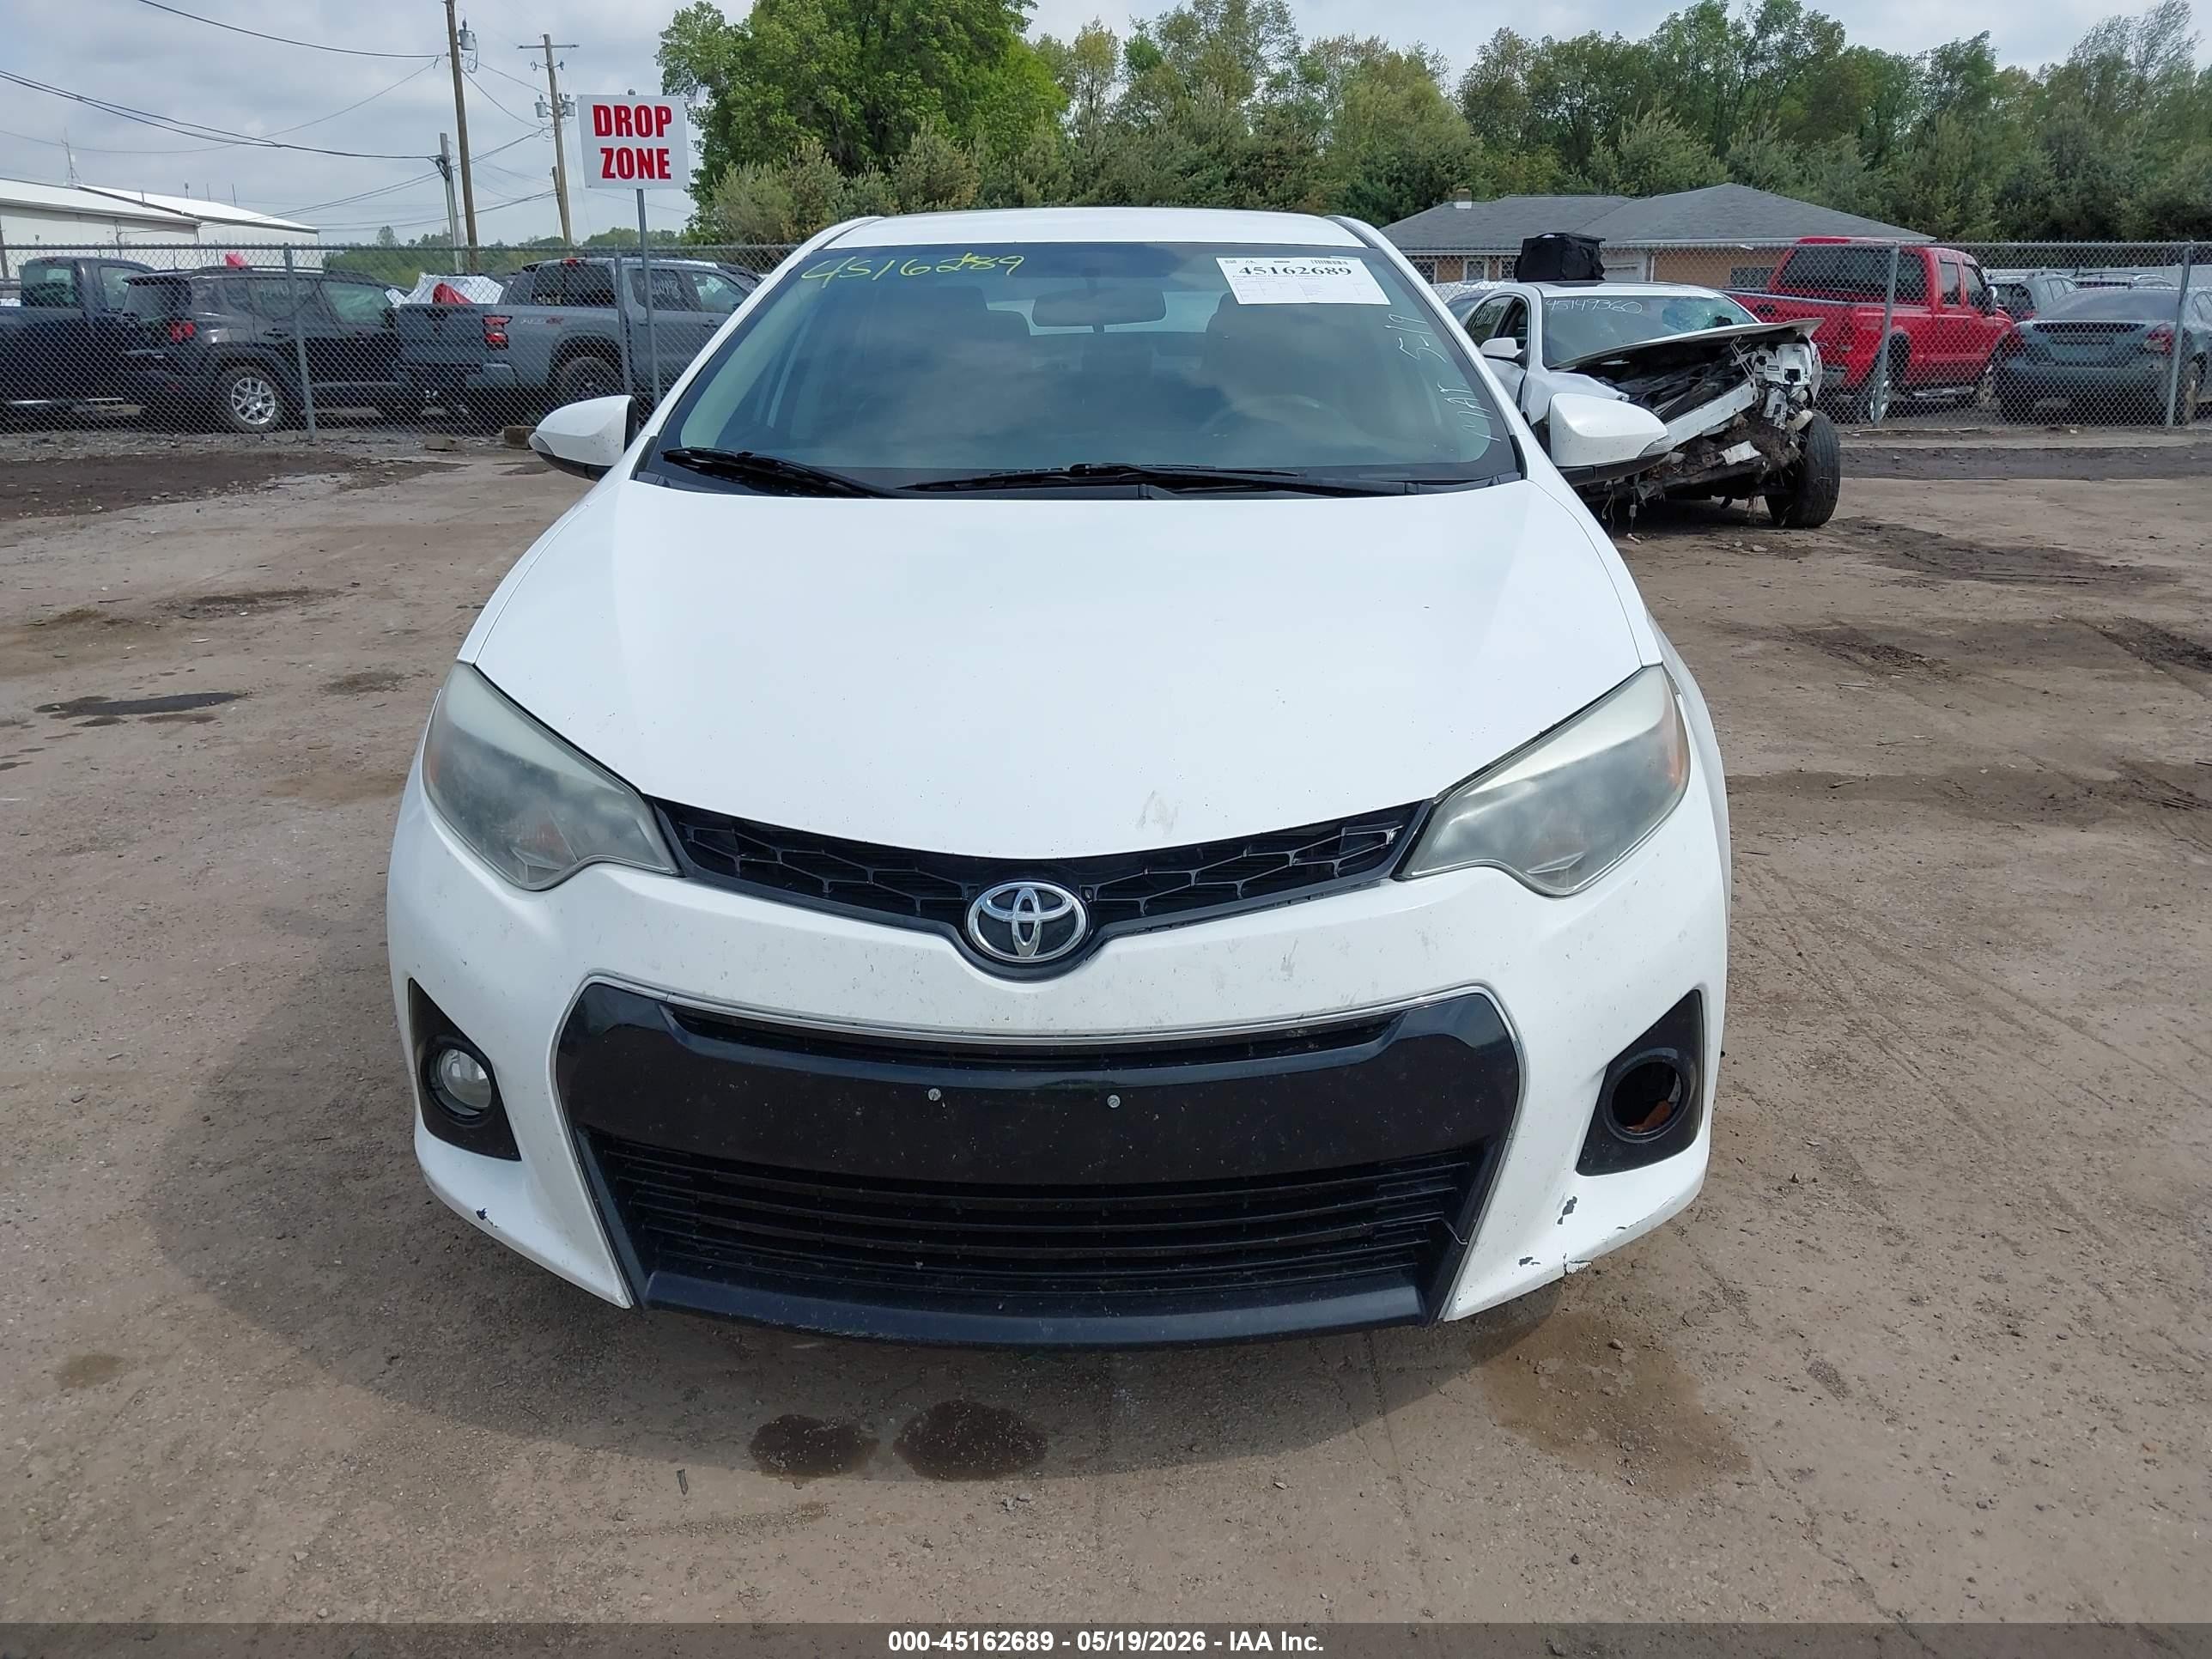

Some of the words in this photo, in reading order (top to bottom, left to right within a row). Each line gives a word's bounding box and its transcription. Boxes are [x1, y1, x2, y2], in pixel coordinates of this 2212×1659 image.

[592, 104, 672, 138] DROP
[600, 147, 672, 179] ZONE
[1238, 265, 1352, 276] 45162689
